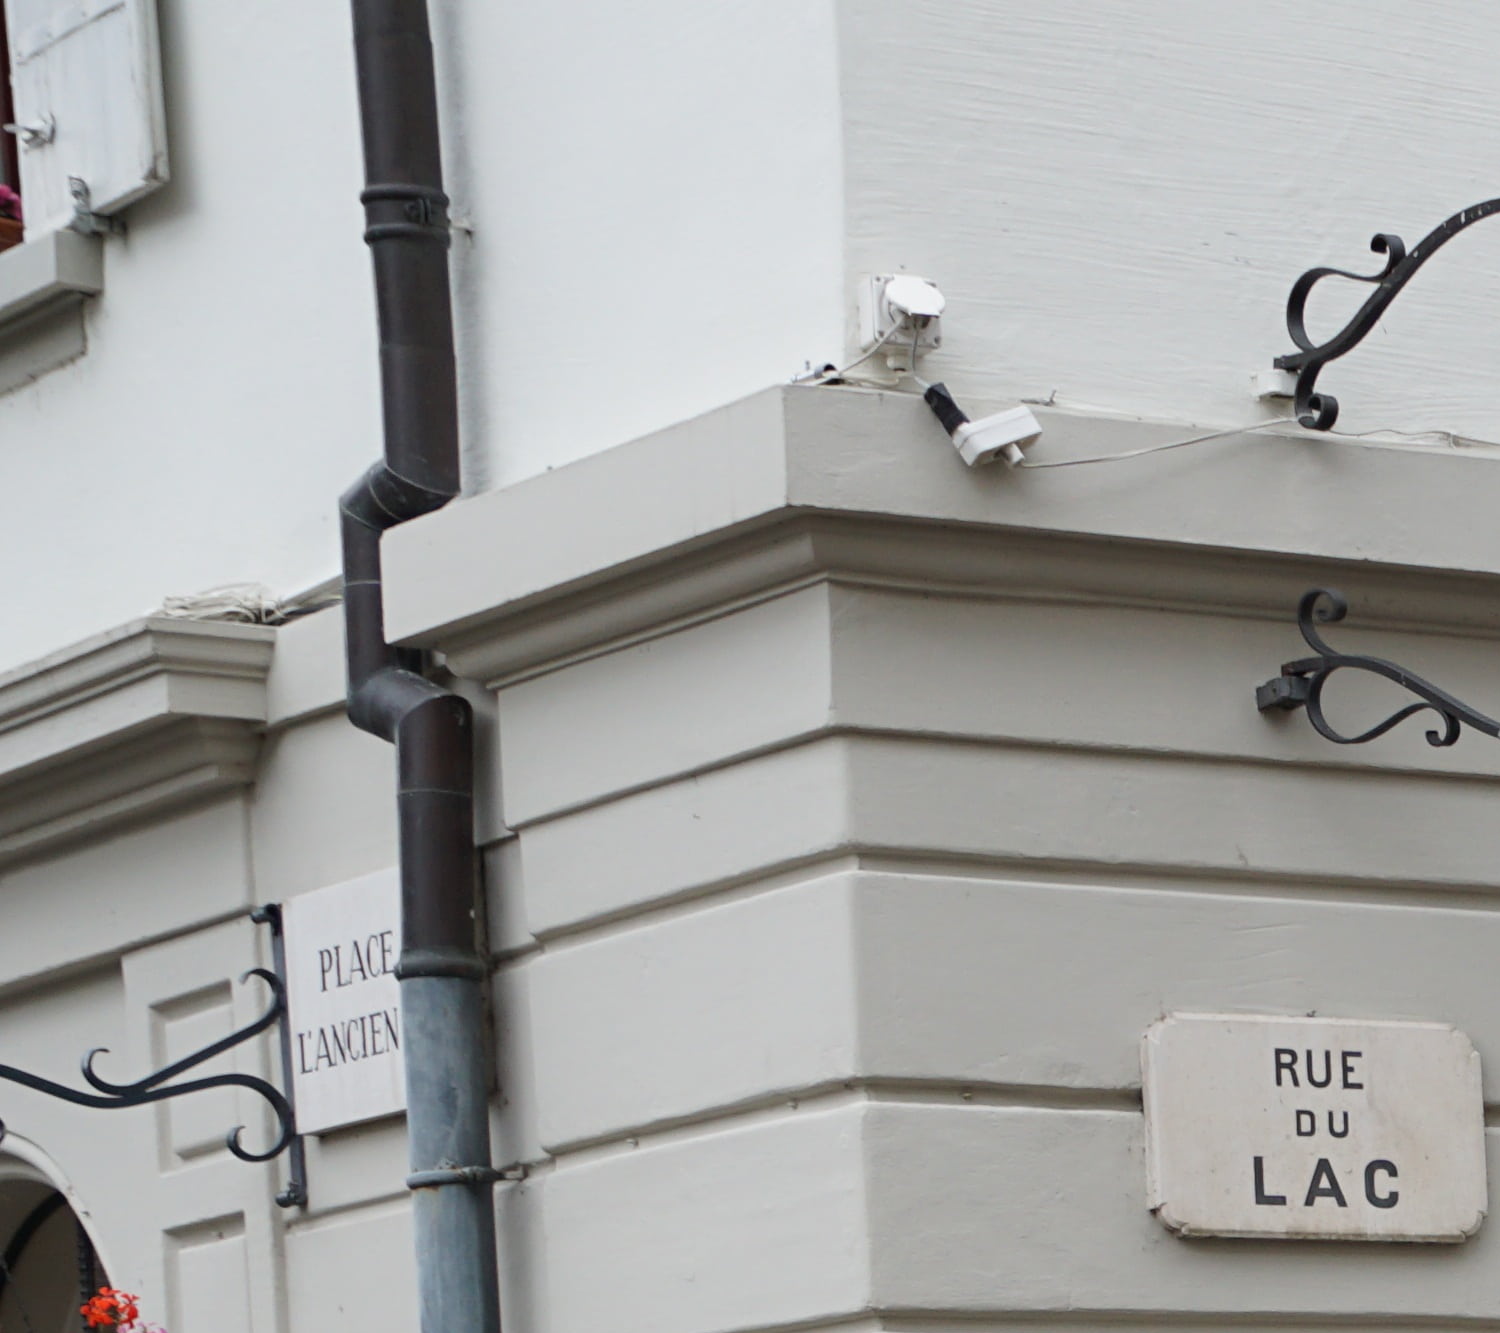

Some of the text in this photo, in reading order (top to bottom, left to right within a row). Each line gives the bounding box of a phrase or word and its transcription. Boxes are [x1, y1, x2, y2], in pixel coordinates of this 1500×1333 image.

[318, 930, 395, 992] PLACE
[298, 1008, 400, 1074] L'ANCIEN
[1274, 1048, 1364, 1090] RUE
[1295, 1109, 1349, 1138] DU
[1253, 1156, 1399, 1209] LAC
